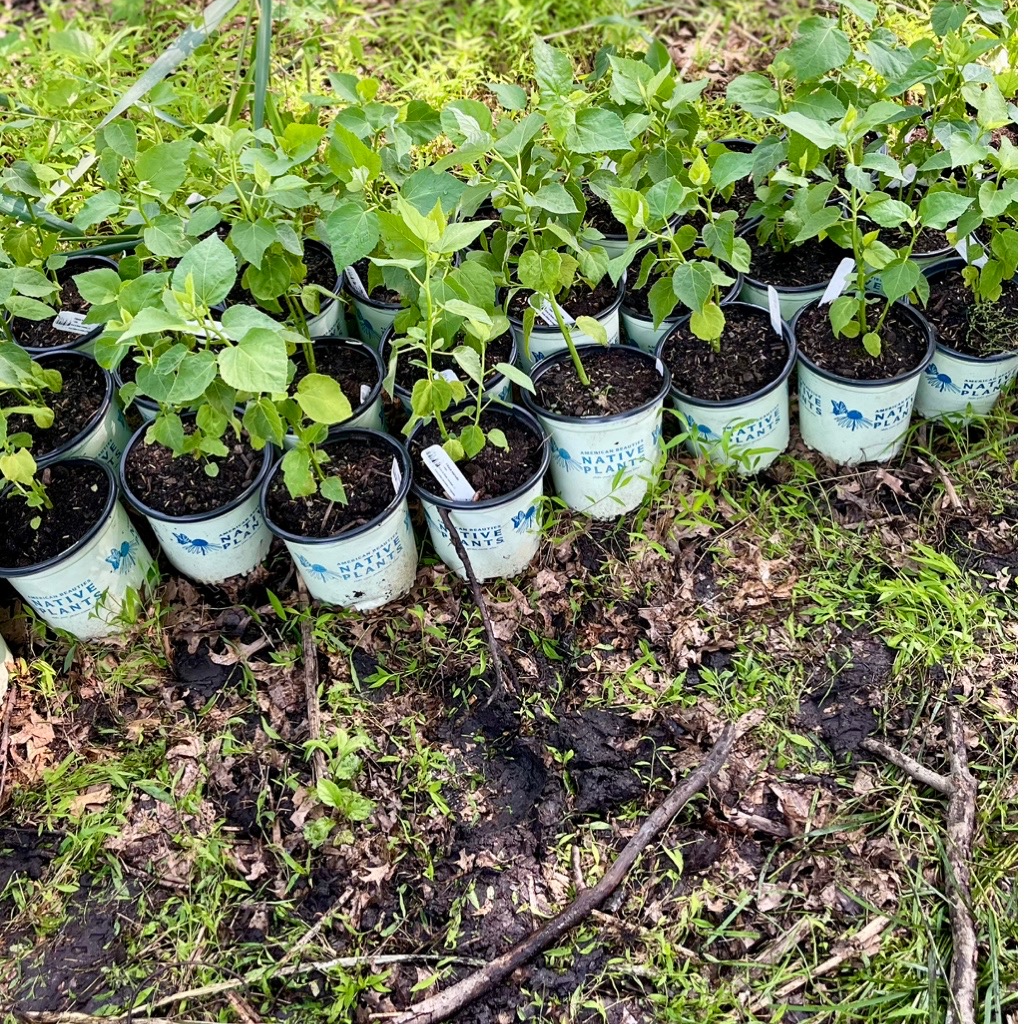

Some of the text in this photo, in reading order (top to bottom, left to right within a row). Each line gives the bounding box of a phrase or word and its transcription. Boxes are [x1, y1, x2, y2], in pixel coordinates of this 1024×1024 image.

[582, 444, 645, 464] NATIVE
[339, 536, 400, 573] NATIVE
[342, 544, 403, 580] PLANTS
[32, 582, 98, 608] NATIVE
